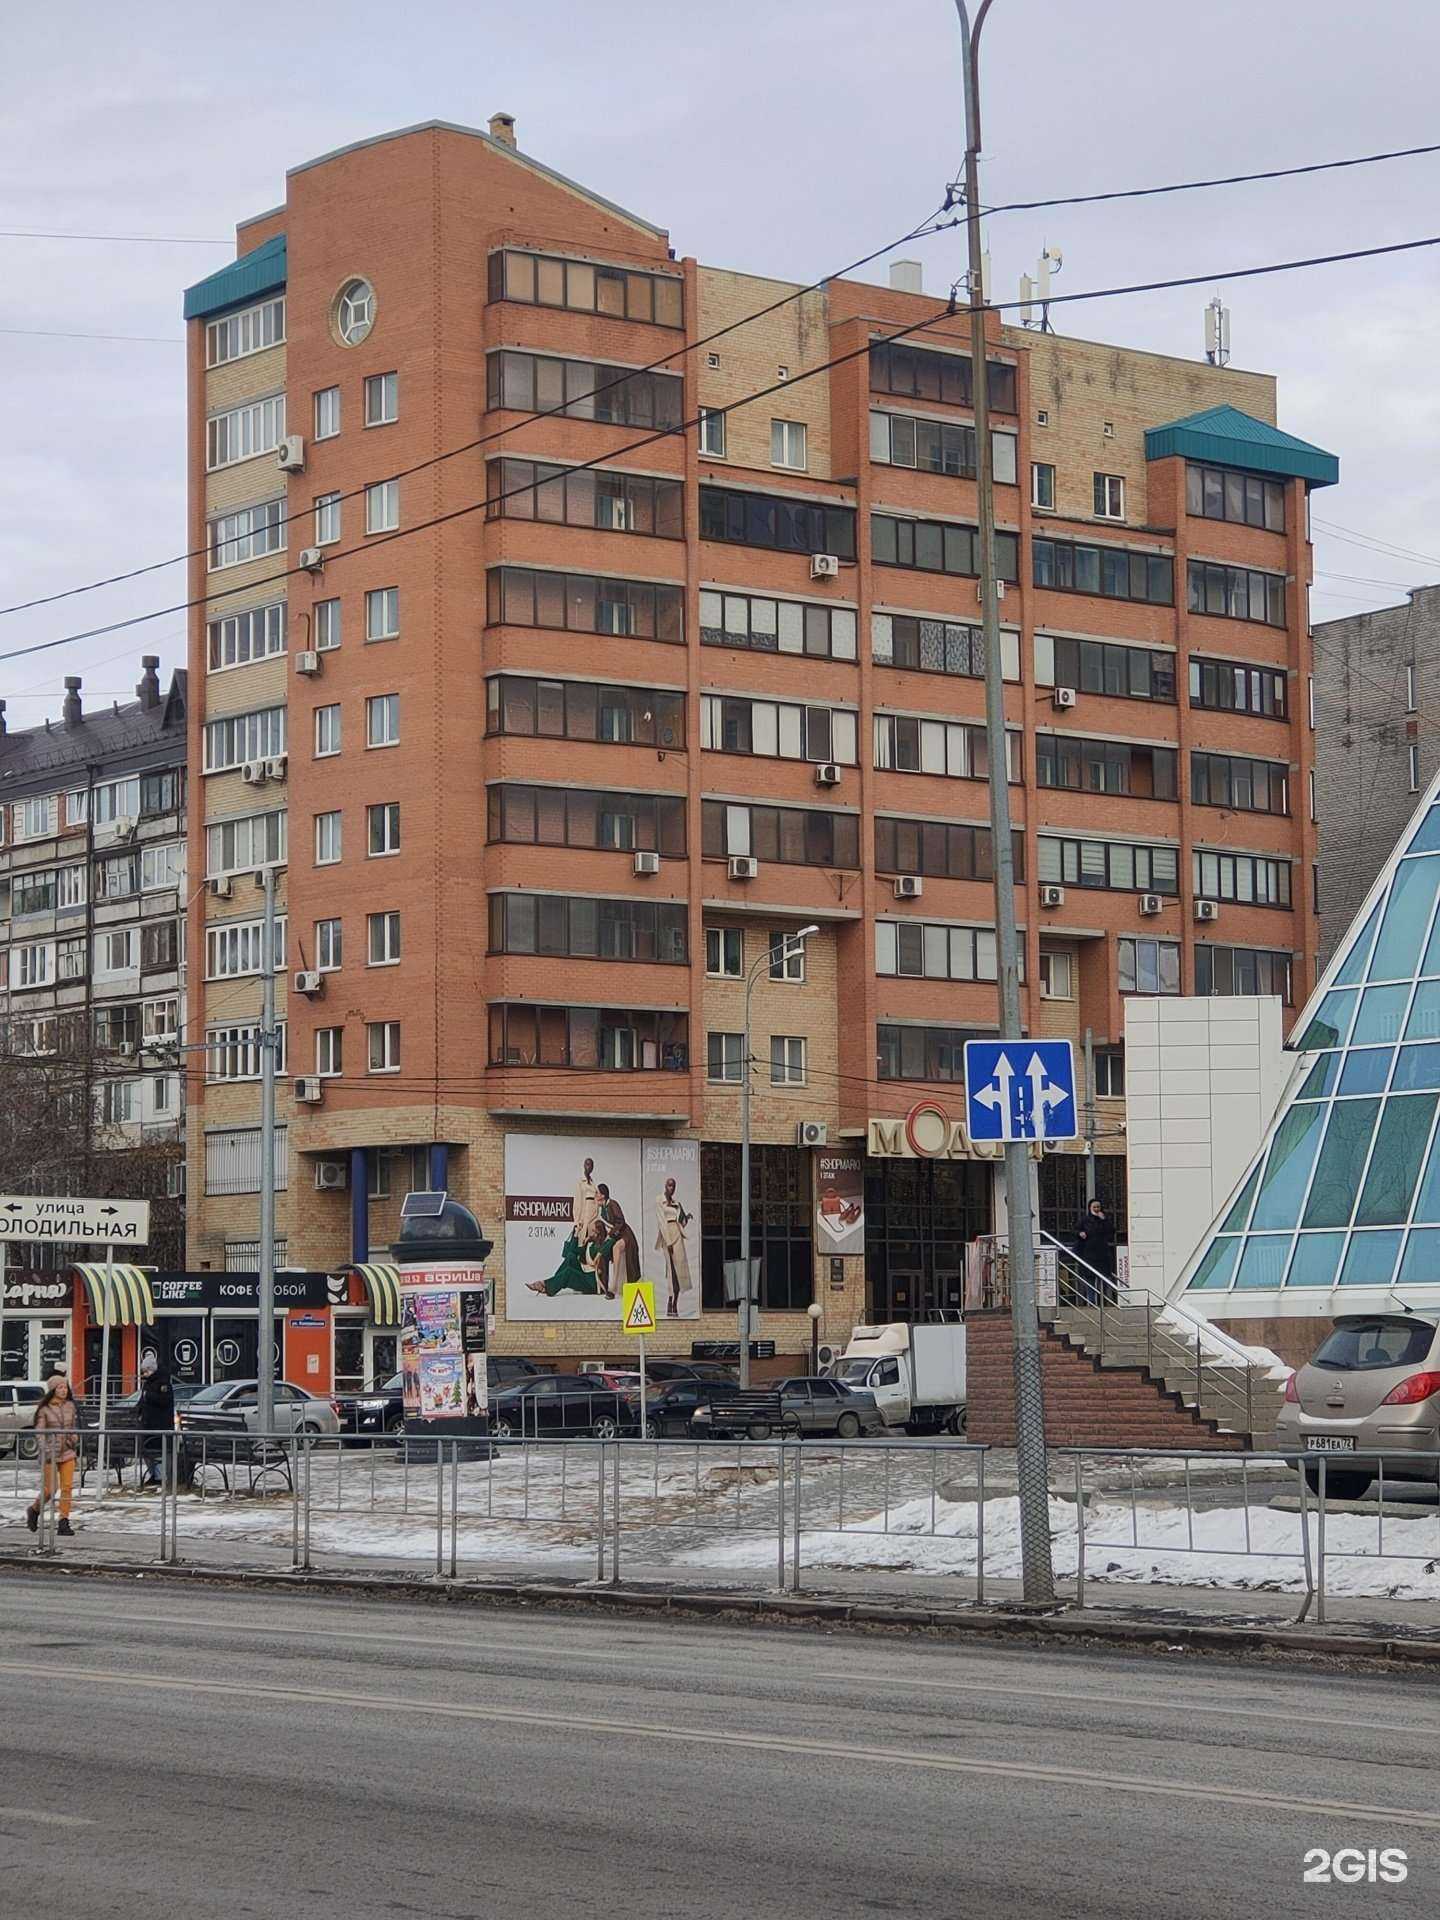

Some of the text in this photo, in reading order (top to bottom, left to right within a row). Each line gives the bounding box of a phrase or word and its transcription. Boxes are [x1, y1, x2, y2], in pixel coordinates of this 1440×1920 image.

[36, 1203, 85, 1216] улица
[513, 1201, 571, 1217] #SHOPMARKI
[162, 1281, 203, 1290] COFFEE
[219, 1284, 253, 1296] КОФЕ
[272, 1283, 307, 1297] ОБОЙ
[162, 1290, 186, 1299] LIKE
